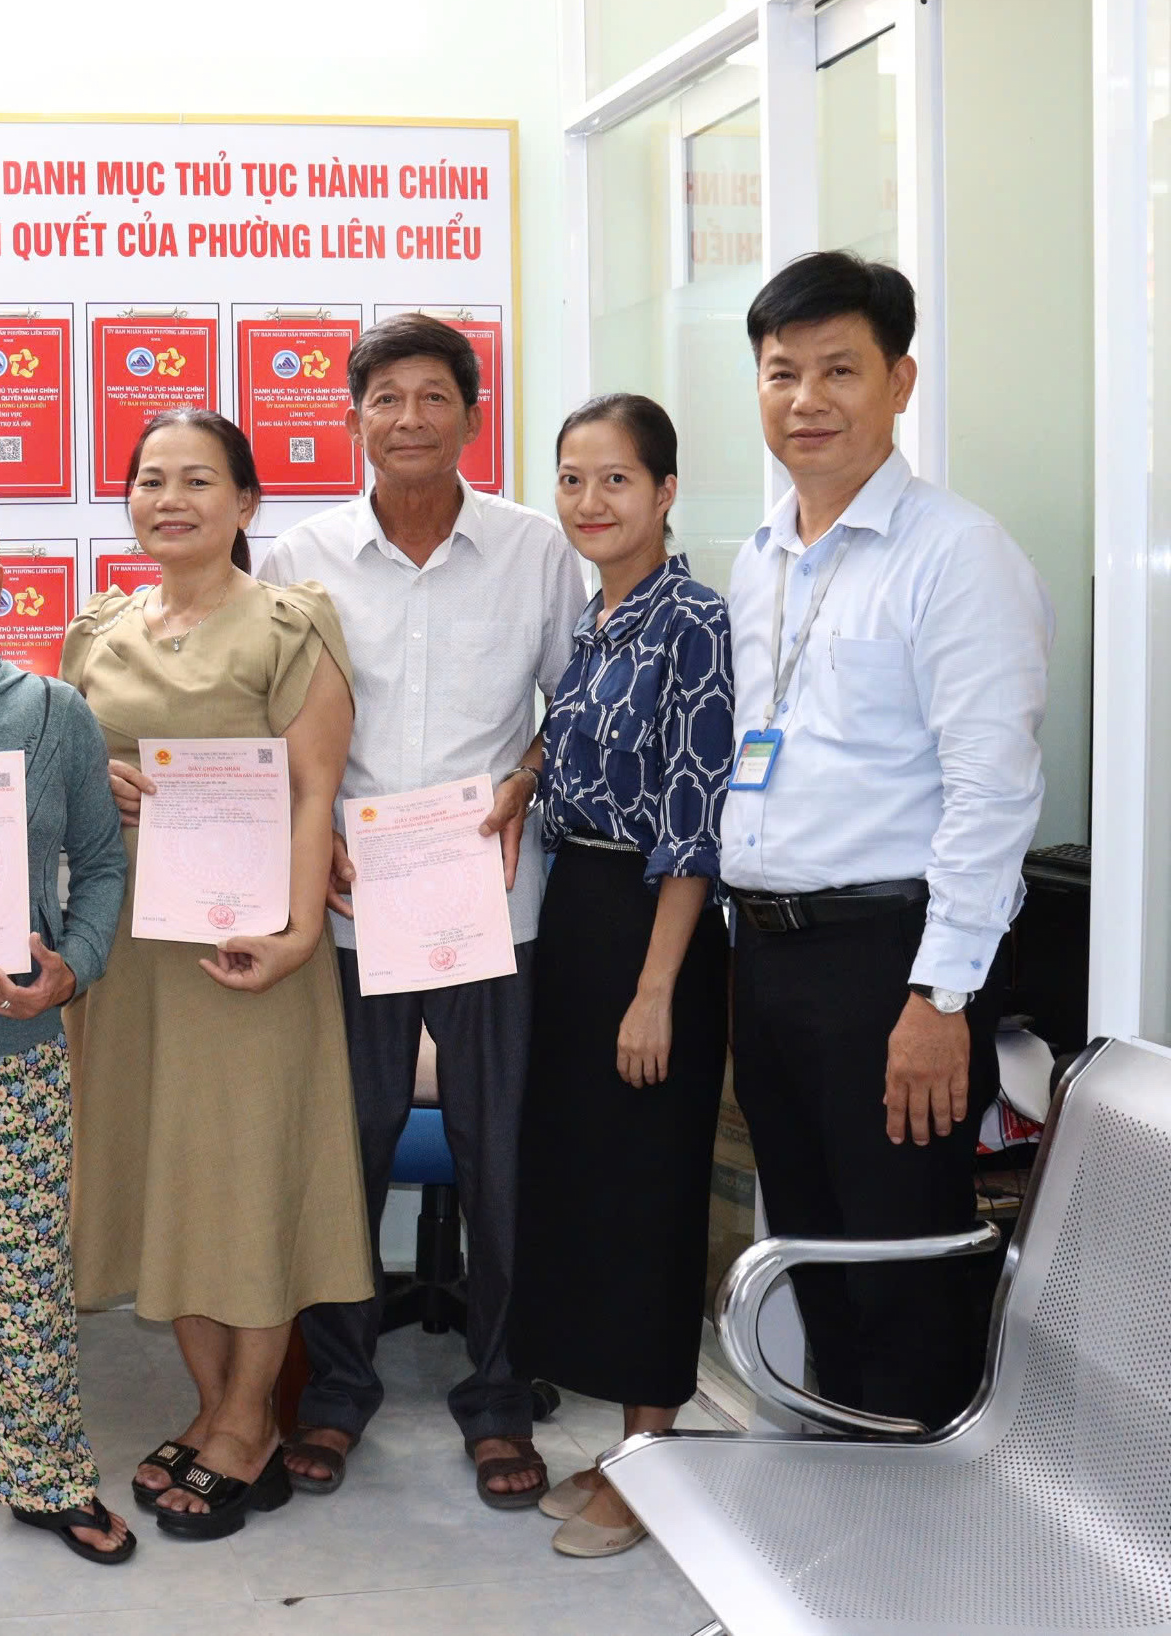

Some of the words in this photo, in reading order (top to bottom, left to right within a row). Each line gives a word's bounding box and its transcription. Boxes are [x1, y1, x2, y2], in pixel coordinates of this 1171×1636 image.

[4, 161, 85, 195] DANH
[97, 161, 165, 204] MỤC
[175, 151, 232, 196] THỦ
[242, 163, 297, 204] TỤC
[308, 156, 388, 198] HÀNH
[399, 159, 488, 200] CHÍNH
[12, 211, 106, 260] QUYẾT
[118, 211, 178, 257] CỦA
[189, 215, 310, 258] PHƯỜNG
[322, 217, 385, 258] LIÊN
[396, 212, 481, 260] CHIỂU
